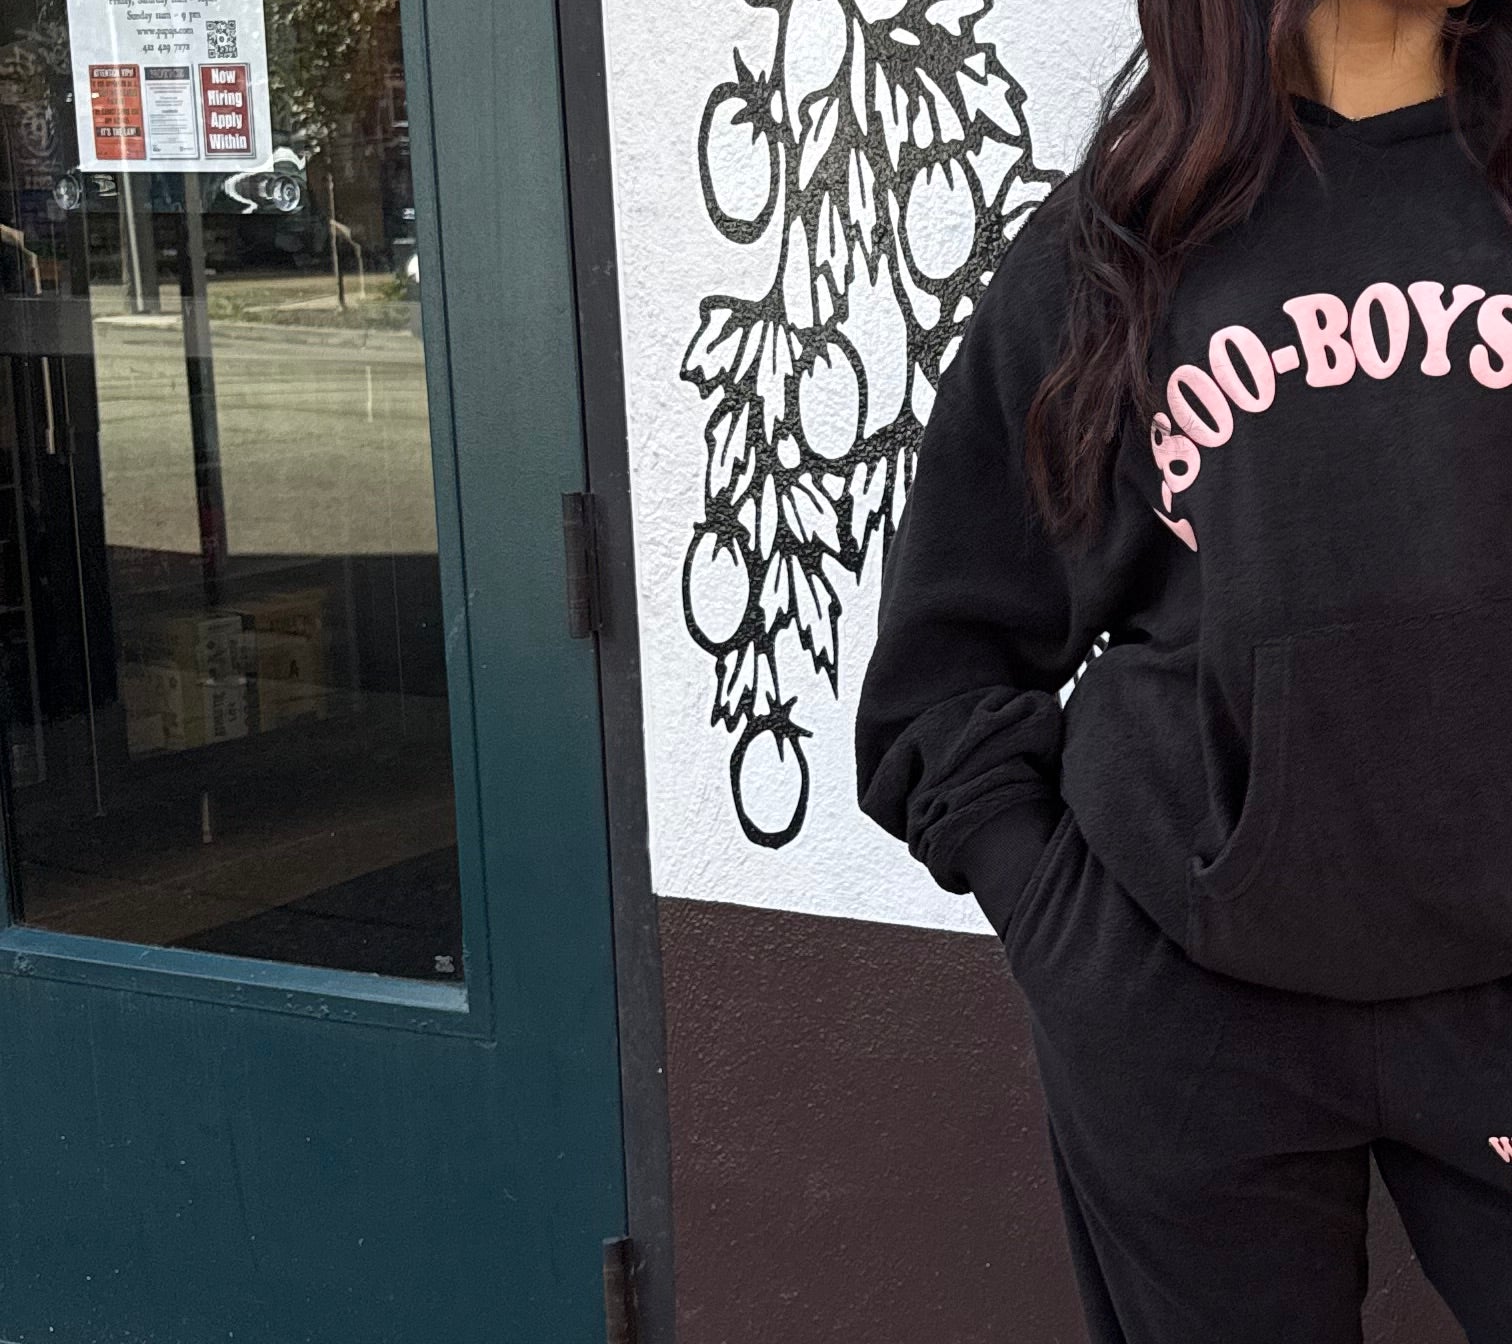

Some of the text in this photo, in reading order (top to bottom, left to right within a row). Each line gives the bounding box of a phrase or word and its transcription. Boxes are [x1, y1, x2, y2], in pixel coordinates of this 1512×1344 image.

[127, 10, 152, 23] Sunday
[211, 68, 236, 83] Now
[207, 90, 243, 107] Hiring
[211, 112, 242, 129] Apply
[209, 133, 247, 150] Within
